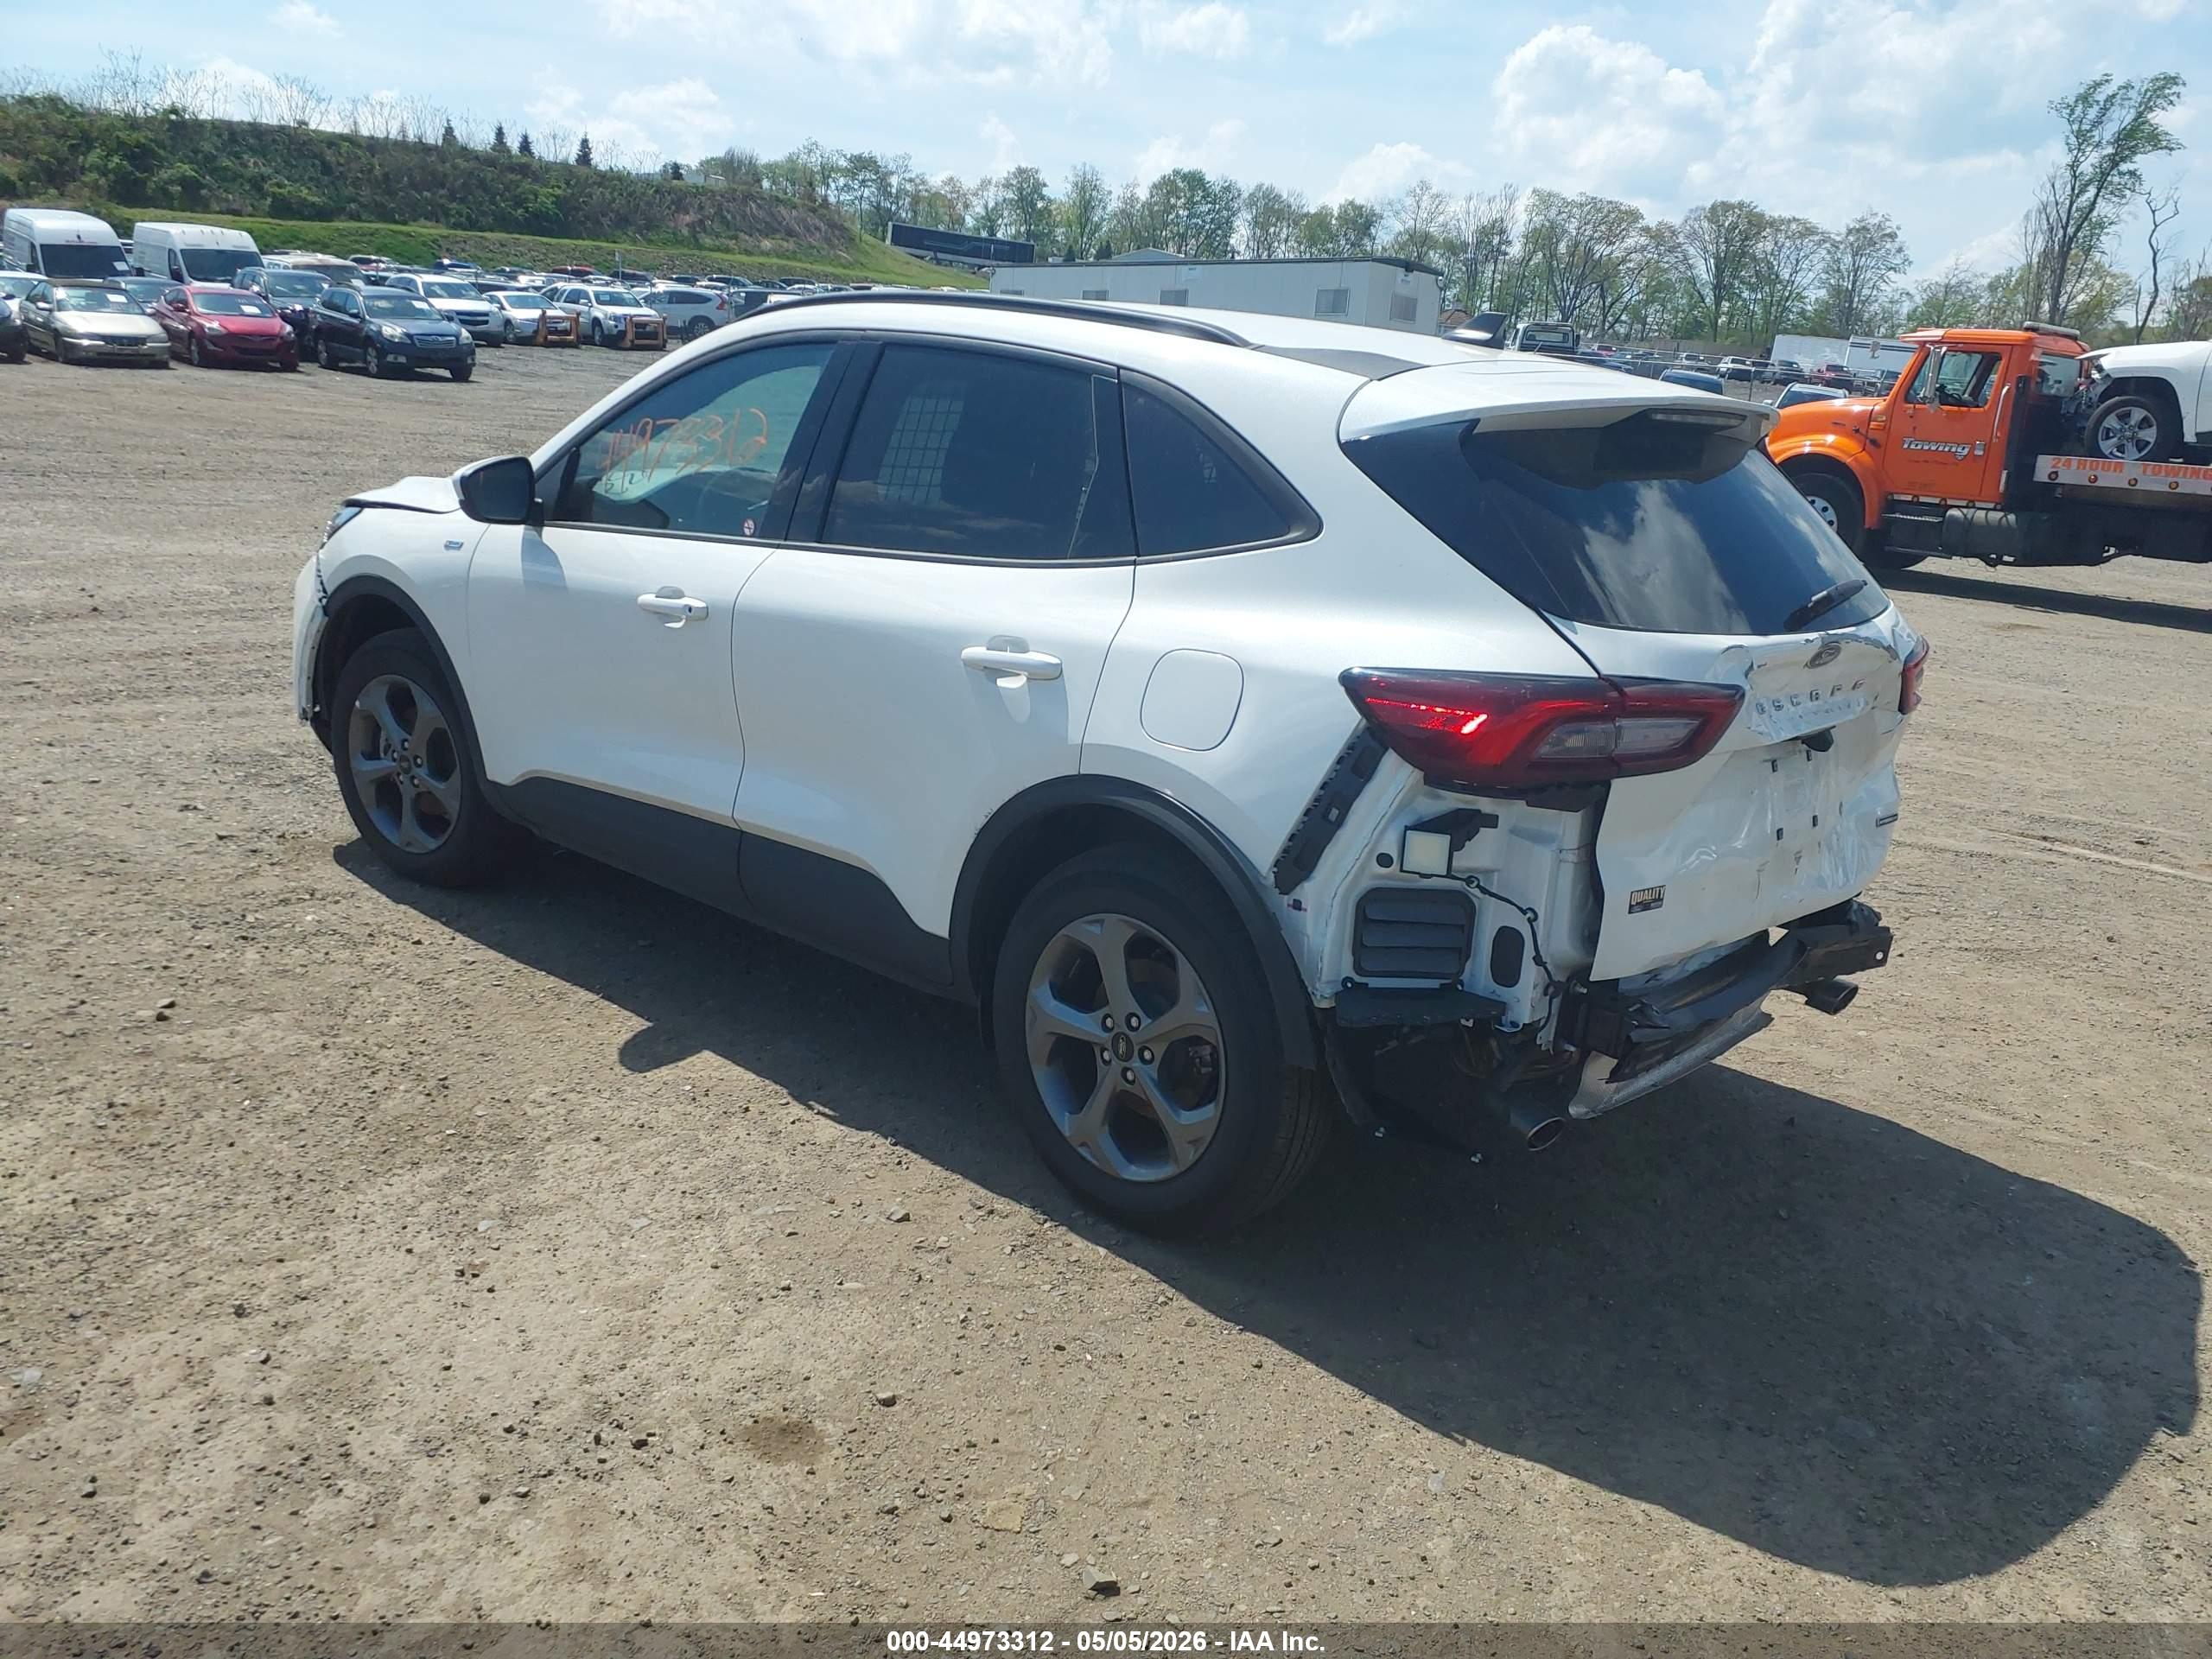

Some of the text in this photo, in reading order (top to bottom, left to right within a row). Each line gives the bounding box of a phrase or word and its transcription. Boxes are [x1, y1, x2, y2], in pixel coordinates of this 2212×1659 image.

[1903, 437, 1971, 456] Towing
[2050, 456, 2073, 470] 24
[2076, 459, 2125, 474] HOUR
[1630, 886, 1666, 906] QUALITY
